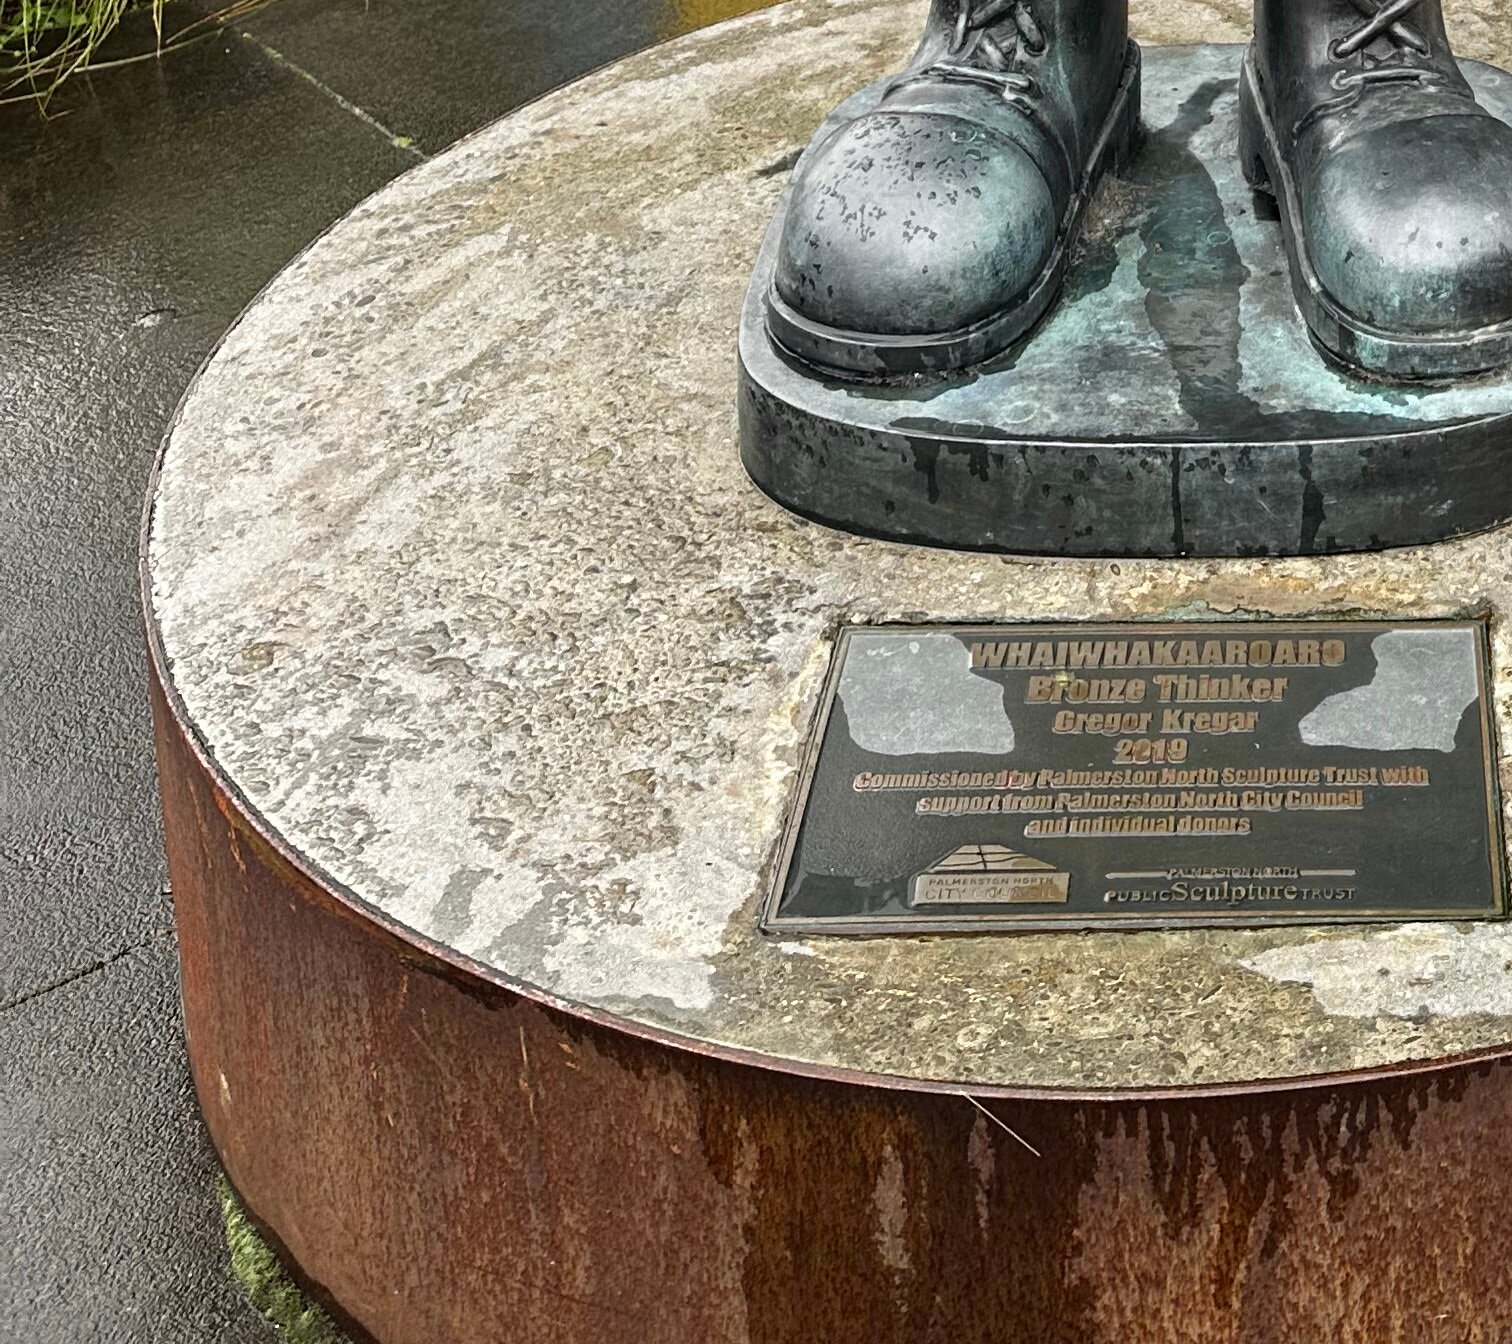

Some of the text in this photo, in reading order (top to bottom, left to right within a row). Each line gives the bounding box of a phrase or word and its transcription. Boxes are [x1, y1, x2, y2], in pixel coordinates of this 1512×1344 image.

[970, 640, 1346, 669] WHAIWHAKAAROARO
[1024, 674, 1289, 704] Bronze Thinker
[1052, 708, 1259, 736] Gregor Kregar
[1112, 738, 1188, 764] 2019
[853, 766, 1430, 791] Commissioned by Palmerston North Sculpture Trust with
[916, 789, 1364, 816] support from Palmerston North City Council
[1024, 815, 1251, 837] and individual donors
[928, 877, 1054, 886] PALMERSTON NORTH
[1166, 867, 1299, 880] PALMERSTON NORTH
[924, 887, 1057, 900] CITY COUNCIL
[1103, 881, 1356, 906] PUBLIC Sculpture TRUST
